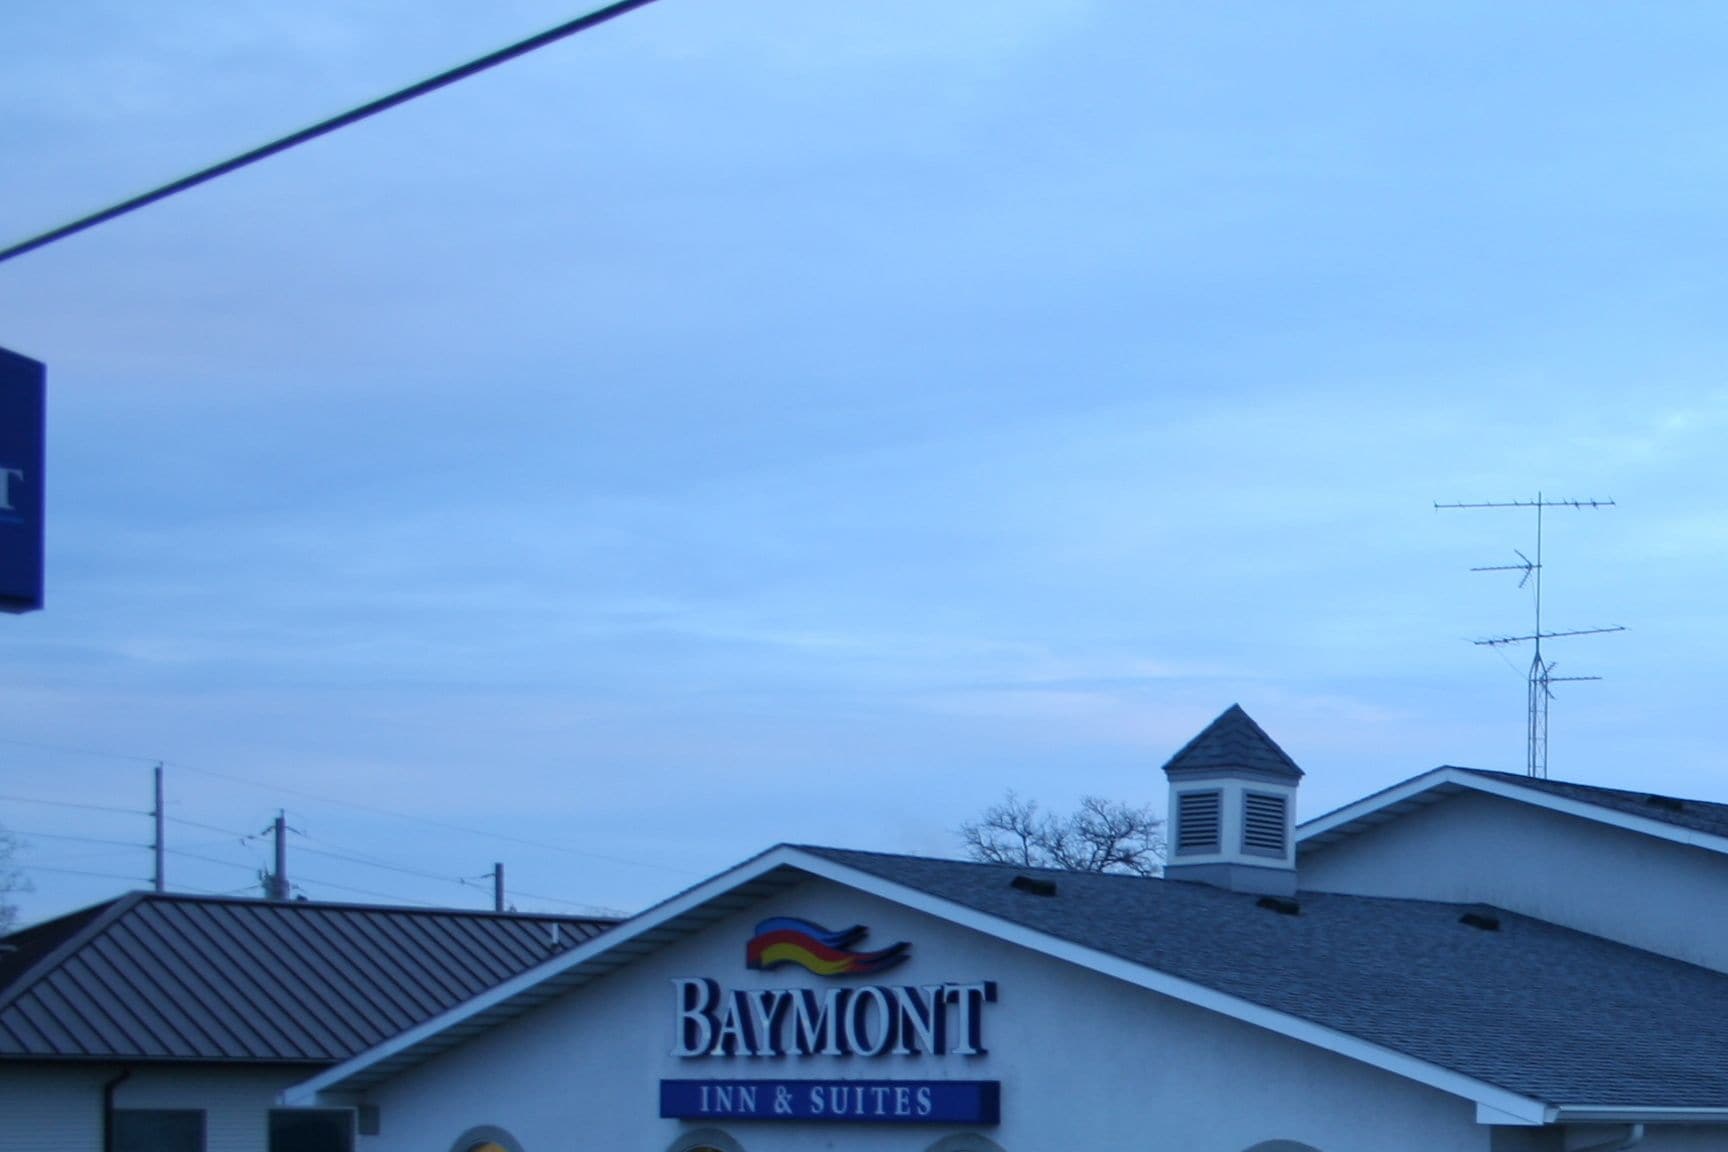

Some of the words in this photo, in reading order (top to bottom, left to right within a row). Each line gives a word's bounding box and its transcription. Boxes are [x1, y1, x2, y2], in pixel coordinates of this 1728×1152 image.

[671, 976, 995, 1058] BAYMONT
[699, 1085, 758, 1113] INN
[774, 1085, 793, 1114] &
[810, 1086, 933, 1116] SUITES
